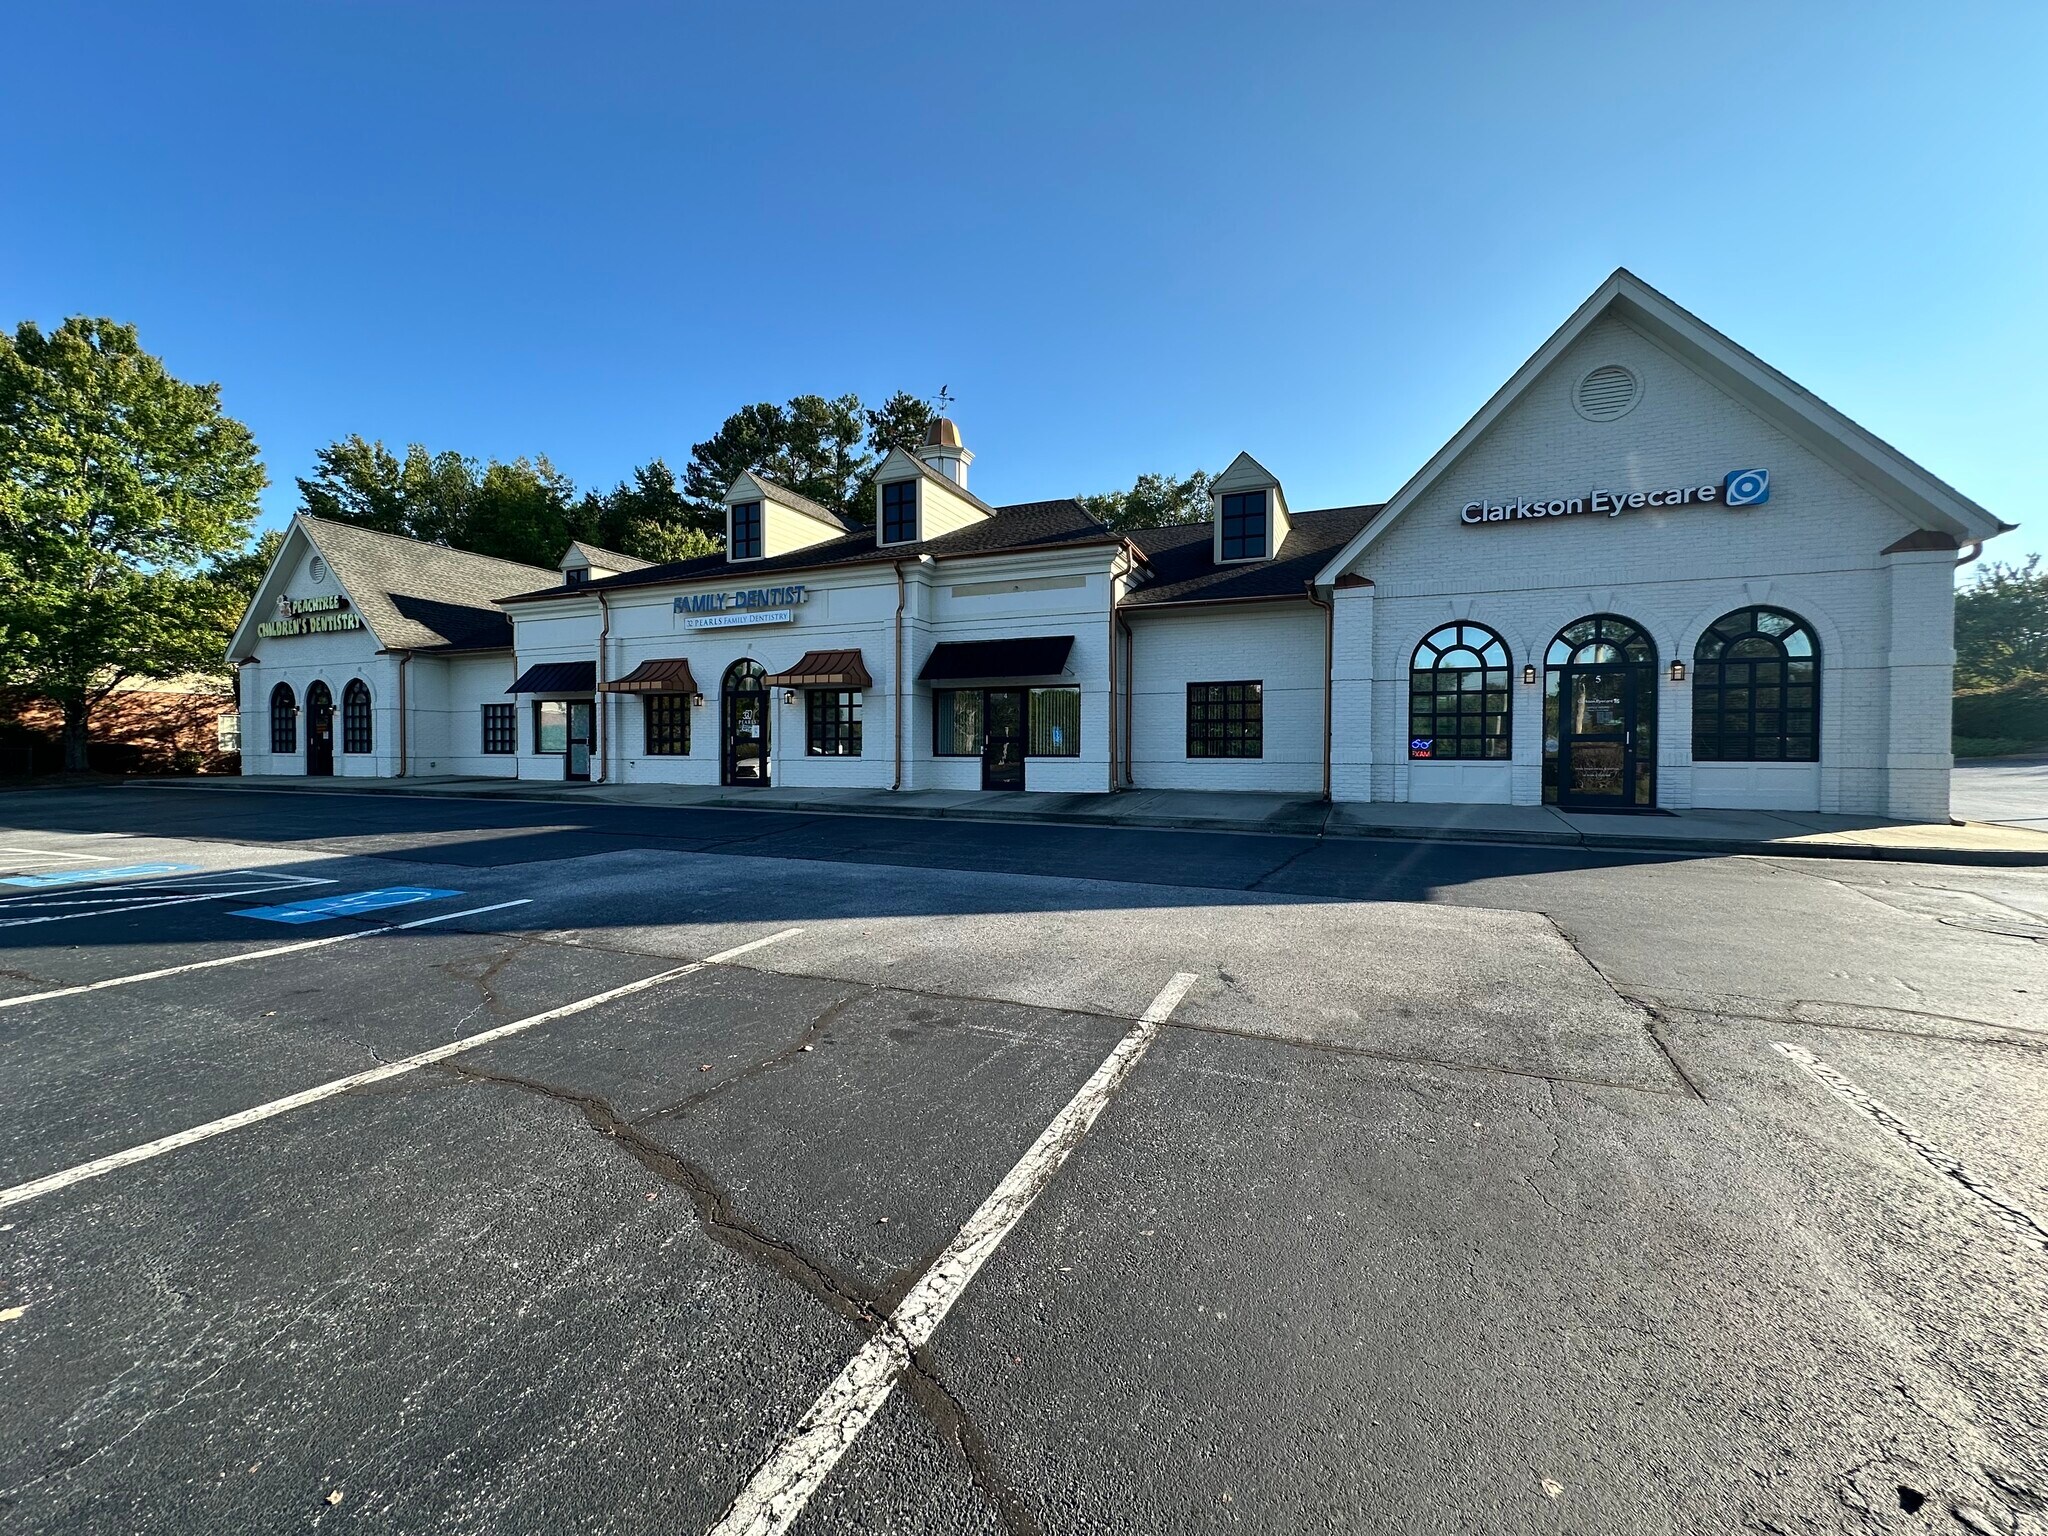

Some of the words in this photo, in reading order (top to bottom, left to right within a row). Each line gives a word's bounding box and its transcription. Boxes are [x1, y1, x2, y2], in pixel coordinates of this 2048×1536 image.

[1461, 496, 1582, 523] Clarkson
[1591, 485, 1716, 517] Eyecare
[292, 595, 340, 614] PEACHTREE
[673, 593, 727, 614] FAMILY
[735, 585, 805, 608] DENTIST
[257, 619, 307, 637] CHILDREN'S
[309, 613, 360, 633] DENTISTRY
[694, 618, 722, 626] PEARLS
[723, 616, 748, 624] FAMILY
[749, 612, 788, 622] DENTISTRY
[1595, 675, 1601, 683] 5
